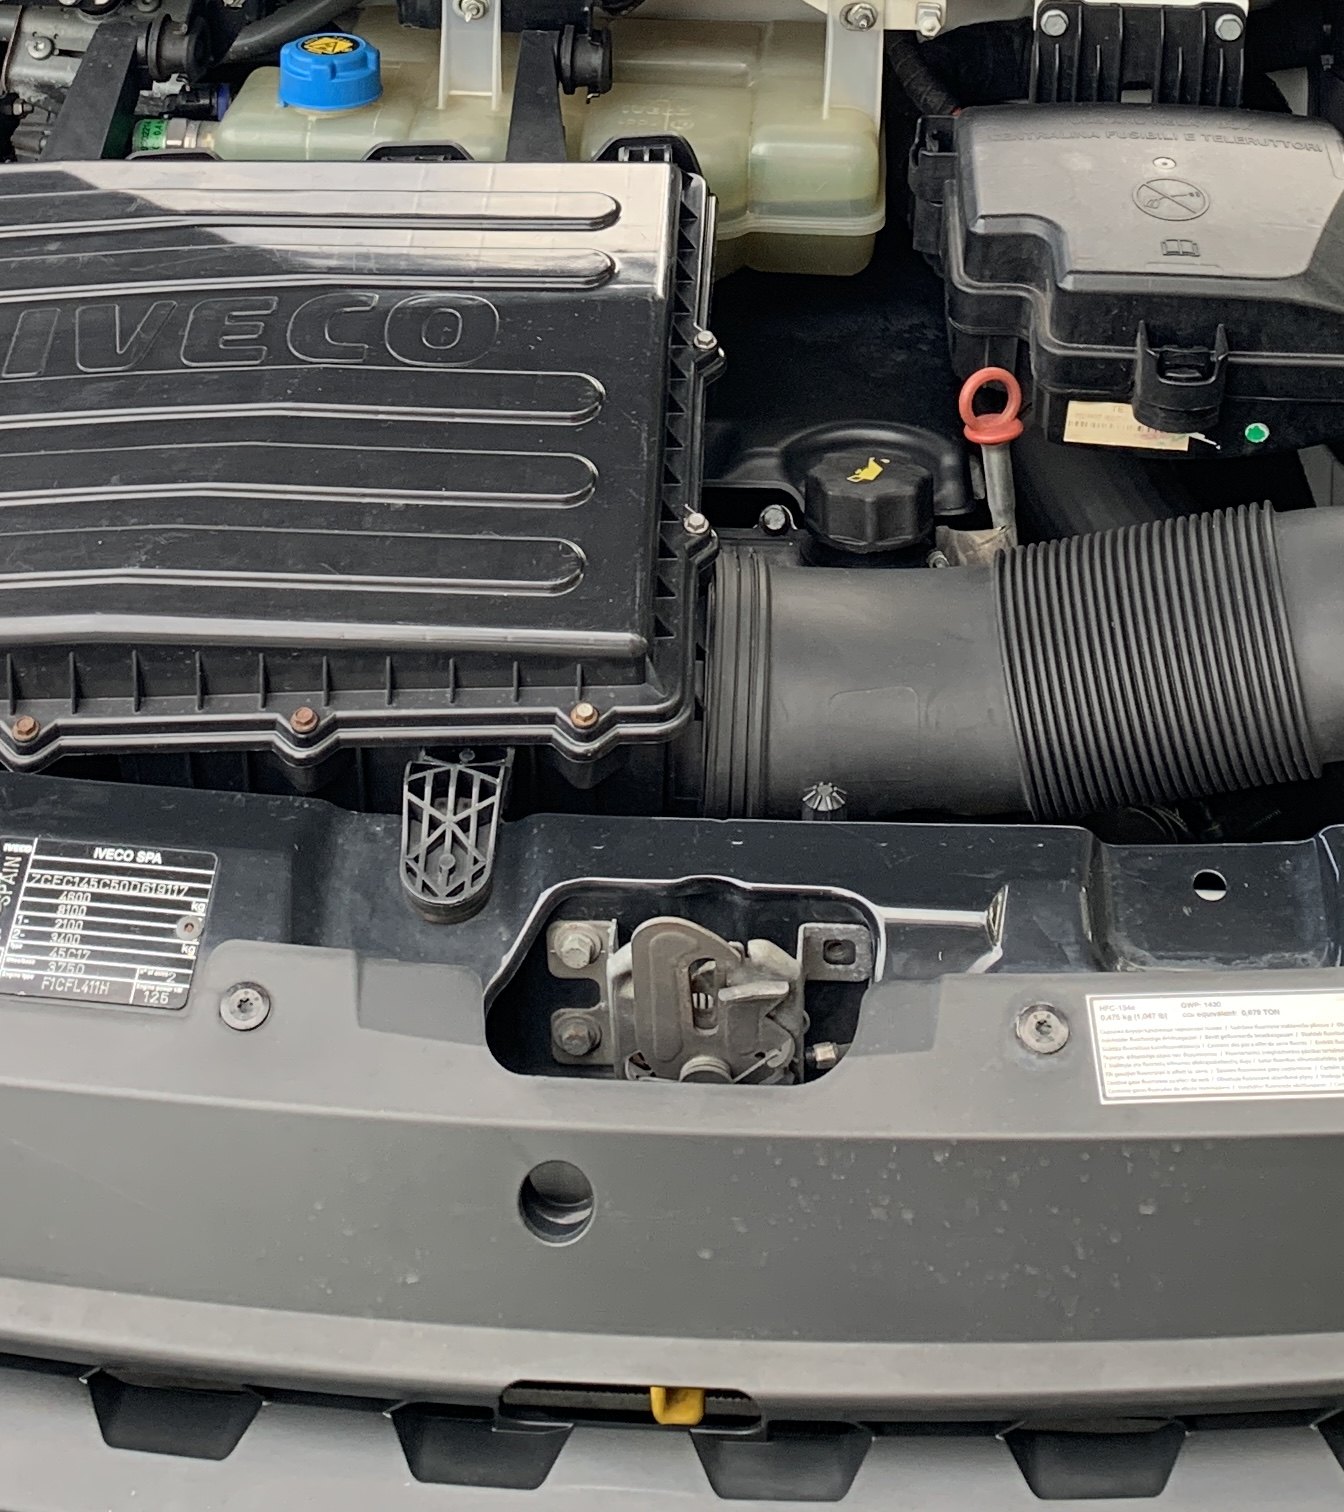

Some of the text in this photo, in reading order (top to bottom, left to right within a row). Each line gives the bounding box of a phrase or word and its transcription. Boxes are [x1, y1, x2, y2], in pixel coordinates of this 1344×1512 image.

[1105, 130, 1179, 141] FUSIBILI
[1184, 133, 1196, 142] E
[1200, 133, 1324, 153] TELERUTTORI
[1, 292, 502, 379] IVECO
[93, 847, 162, 864] IVECO SPA
[0, 856, 22, 906] SPAIN
[58, 891, 92, 904] 4600
[57, 904, 87, 917] 8100
[191, 901, 206, 913] kg
[55, 918, 84, 931] 2100
[49, 932, 81, 945] 3400
[49, 947, 91, 961] 45C17
[181, 943, 196, 956] kg
[47, 961, 85, 975] 3750
[166, 972, 176, 983] 2
[41, 976, 110, 995] F1CFL411H
